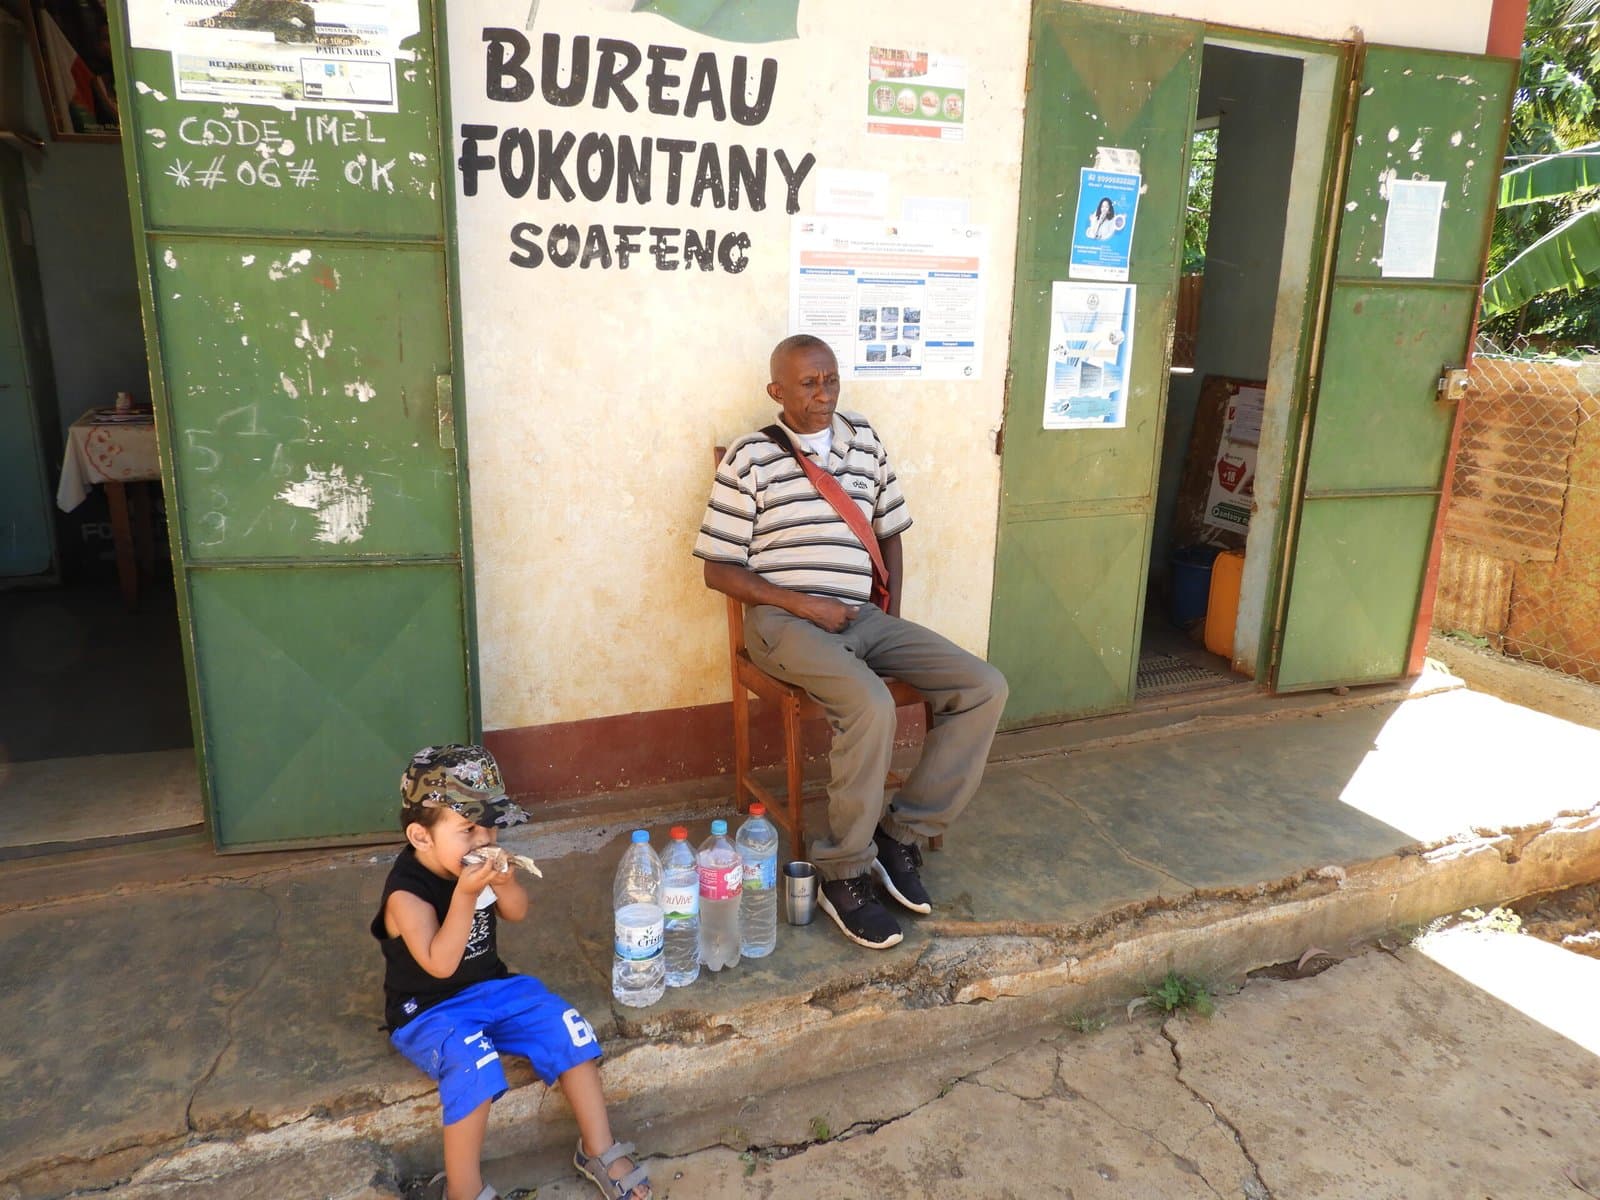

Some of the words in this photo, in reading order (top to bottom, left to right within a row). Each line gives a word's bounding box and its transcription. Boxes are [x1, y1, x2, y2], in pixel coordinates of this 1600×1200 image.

[316, 46, 381, 56] PARTENAIRES
[482, 27, 778, 126] BUREAU
[178, 116, 283, 146] CODE
[305, 116, 386, 146] IMEL
[344, 158, 397, 193] OK
[458, 124, 816, 215] FOKONTANY
